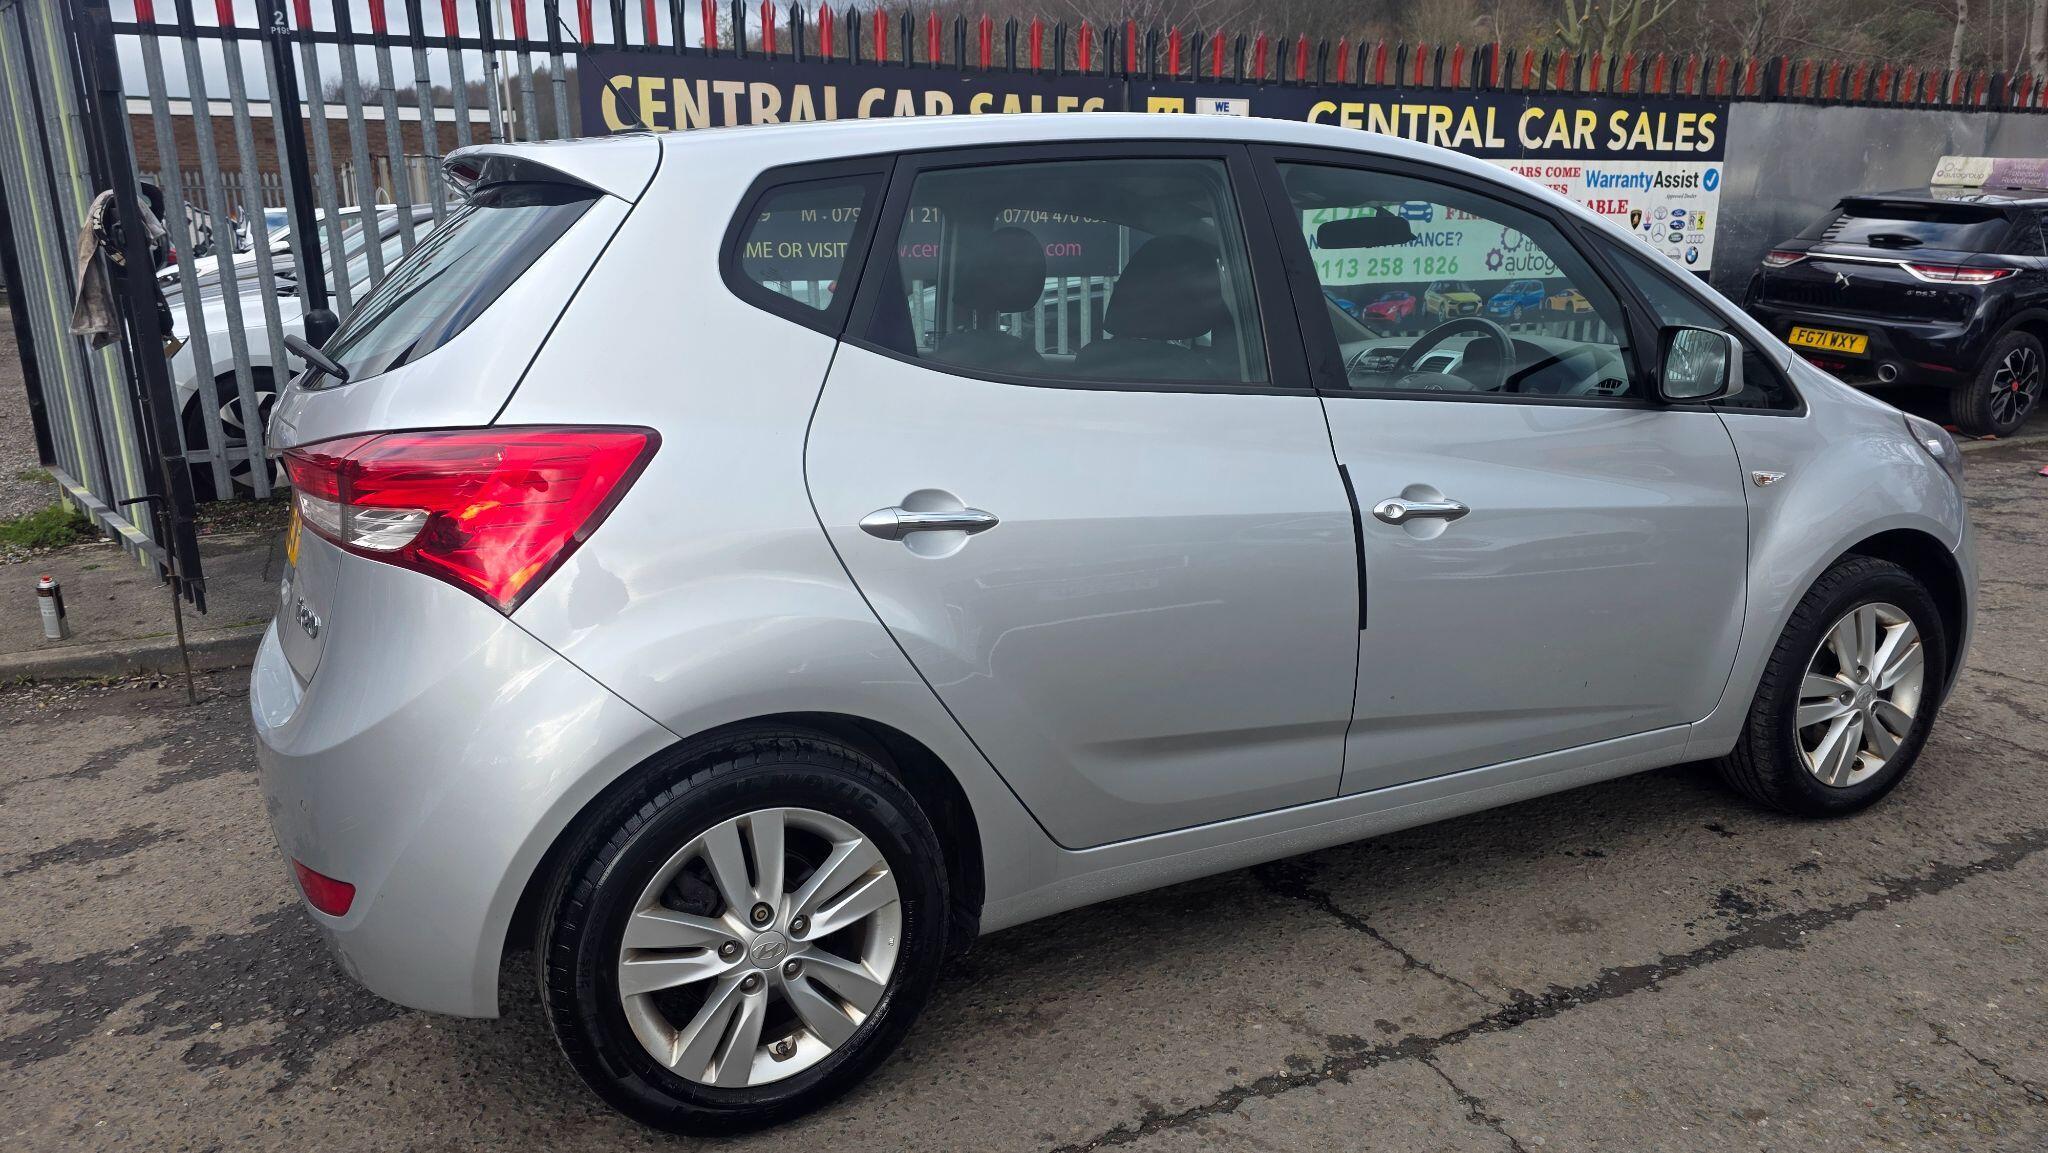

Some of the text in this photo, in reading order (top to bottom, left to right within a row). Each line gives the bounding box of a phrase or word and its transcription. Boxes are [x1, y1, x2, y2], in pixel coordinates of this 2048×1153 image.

[273, 10, 285, 25] 2
[601, 74, 838, 132] CENTRAL
[1215, 102, 1229, 112] WE
[1307, 101, 1717, 152] CENTRAL CAR SALES
[1545, 167, 1581, 178] COME
[778, 242, 803, 258] OR
[807, 242, 848, 258] VISIT
[1315, 256, 1459, 279] 113 258 1826
[1505, 253, 1559, 275] autog
[1797, 329, 1858, 349] FG71 WXY
